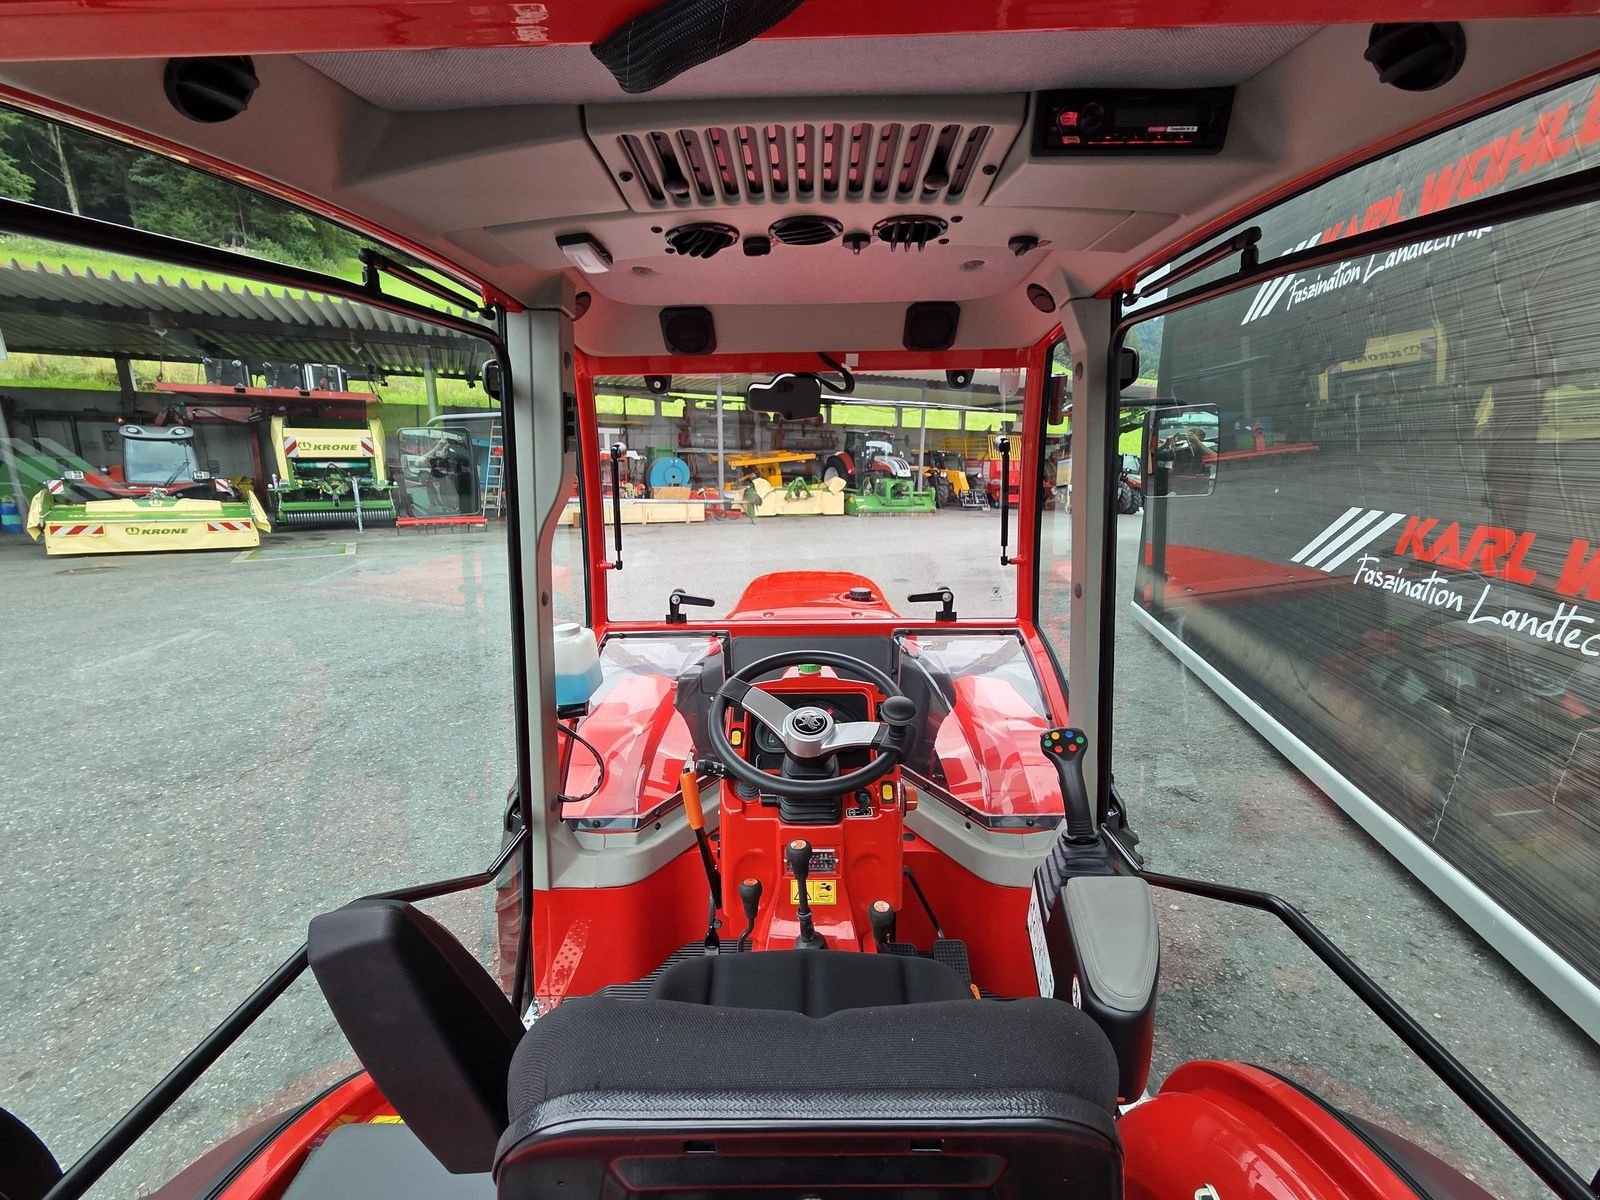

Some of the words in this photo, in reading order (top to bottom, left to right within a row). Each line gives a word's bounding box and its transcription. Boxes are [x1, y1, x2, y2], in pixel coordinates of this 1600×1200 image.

[1286, 261, 1361, 311] Faszination
[1393, 515, 1537, 585] KARL
[1353, 553, 1463, 612] Faszination
